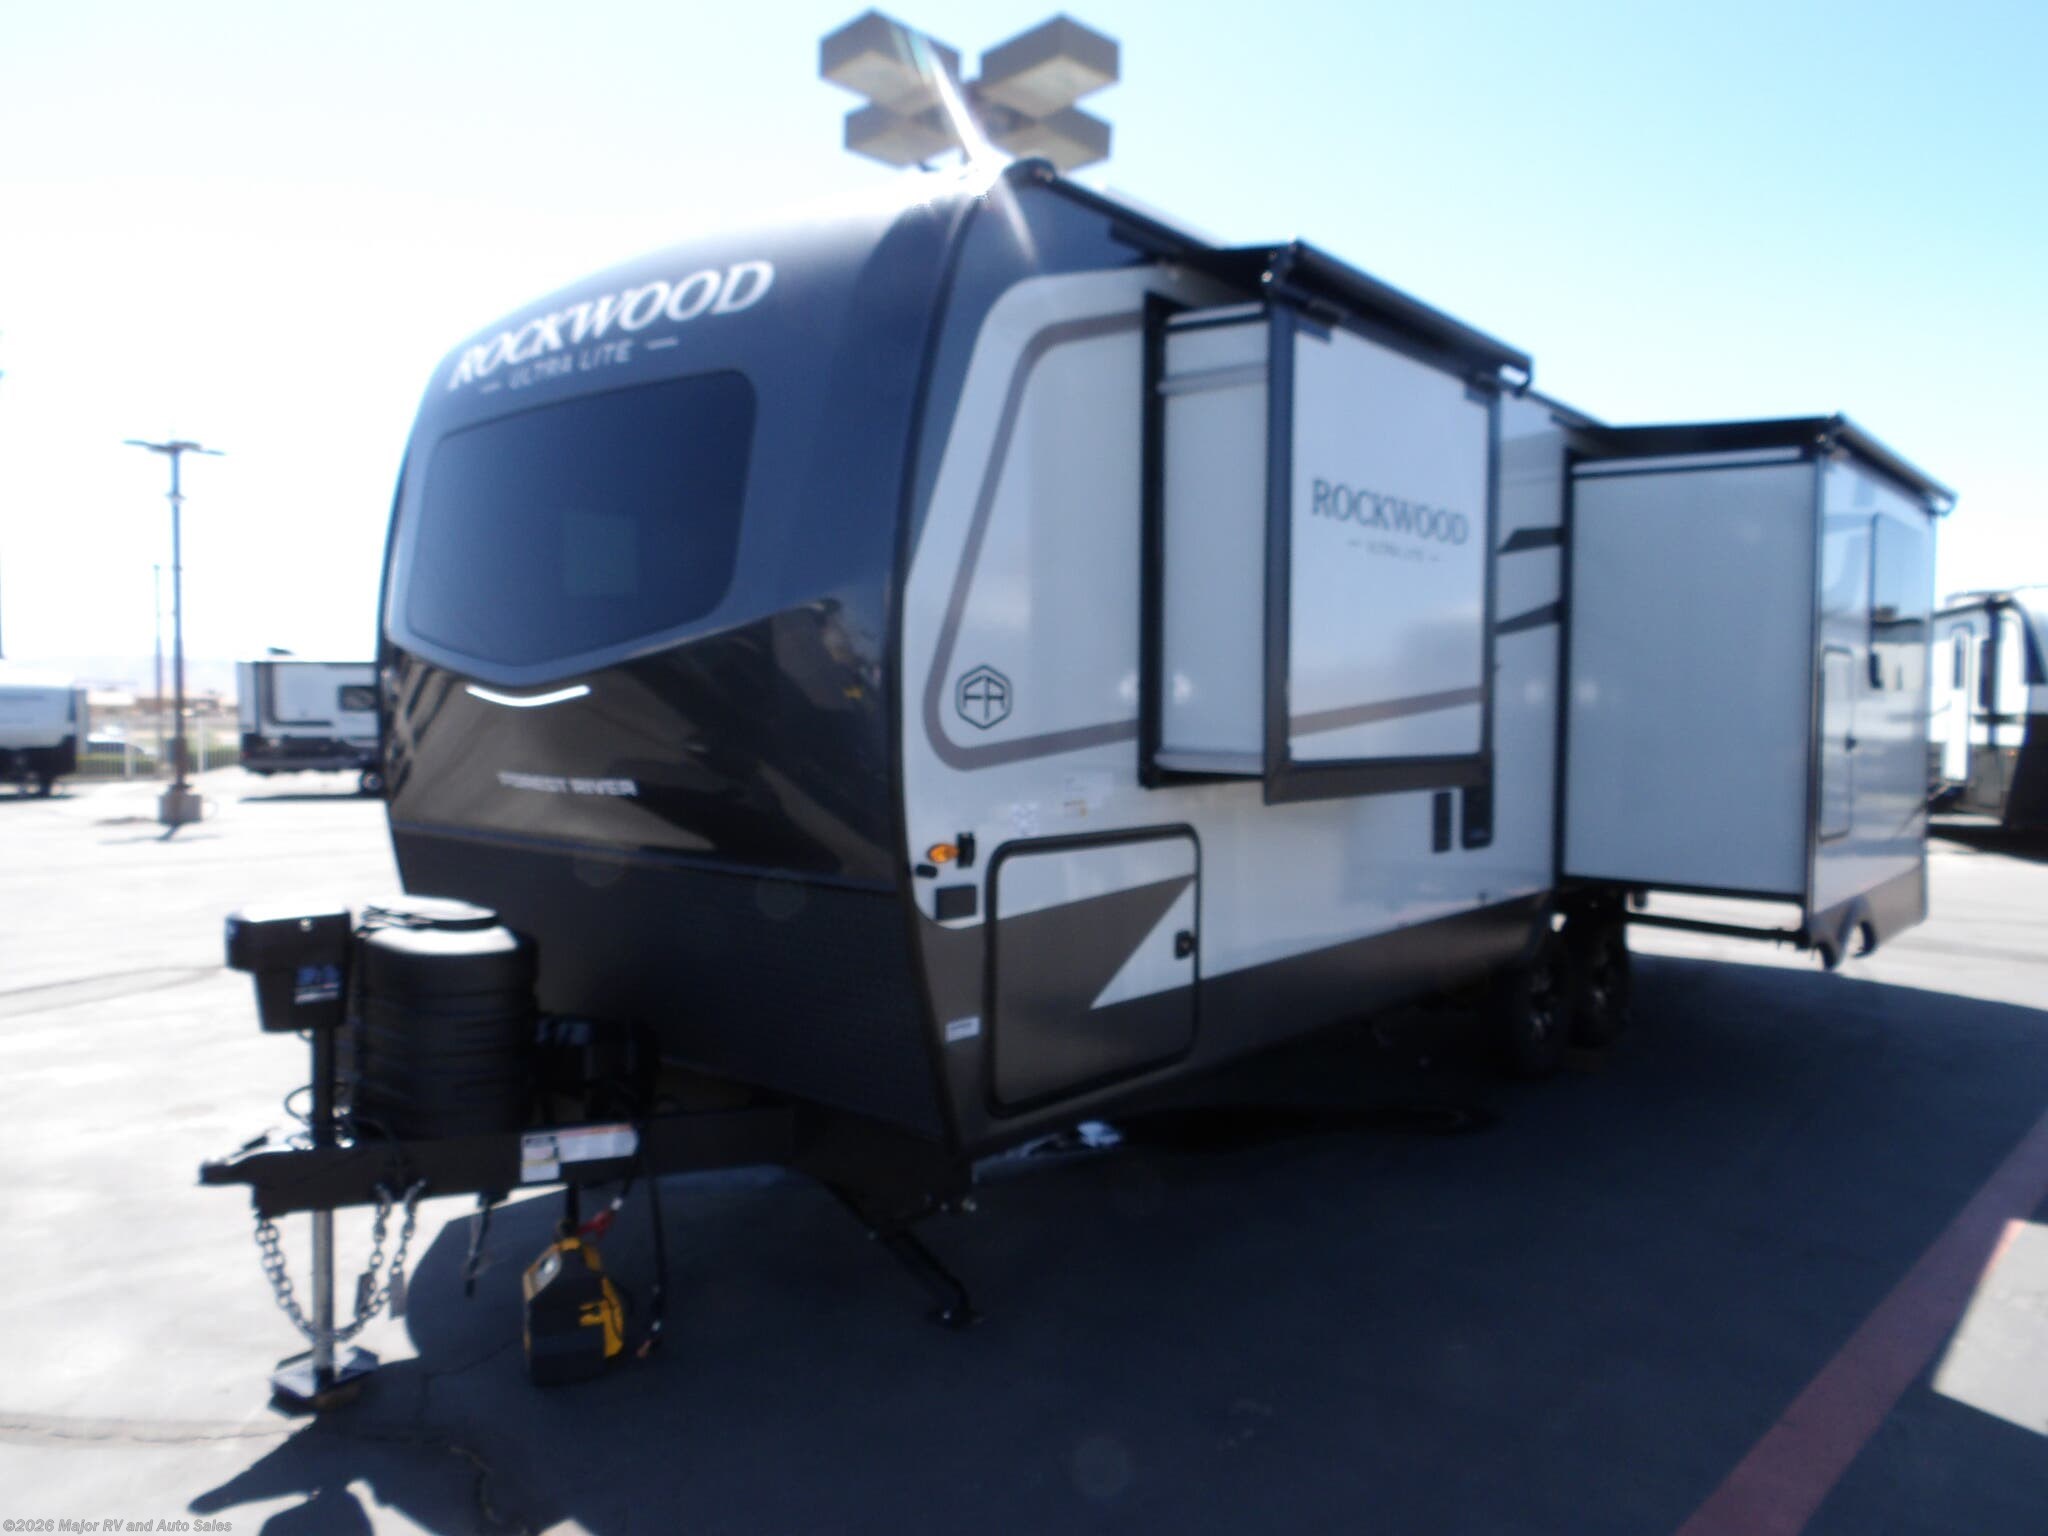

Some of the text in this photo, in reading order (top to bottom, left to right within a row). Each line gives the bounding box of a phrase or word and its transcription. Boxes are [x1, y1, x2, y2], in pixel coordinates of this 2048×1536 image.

[447, 259, 775, 393] ROCKWOOD
[579, 339, 634, 371] LITE
[1311, 477, 1470, 546] ROCKWOOD
